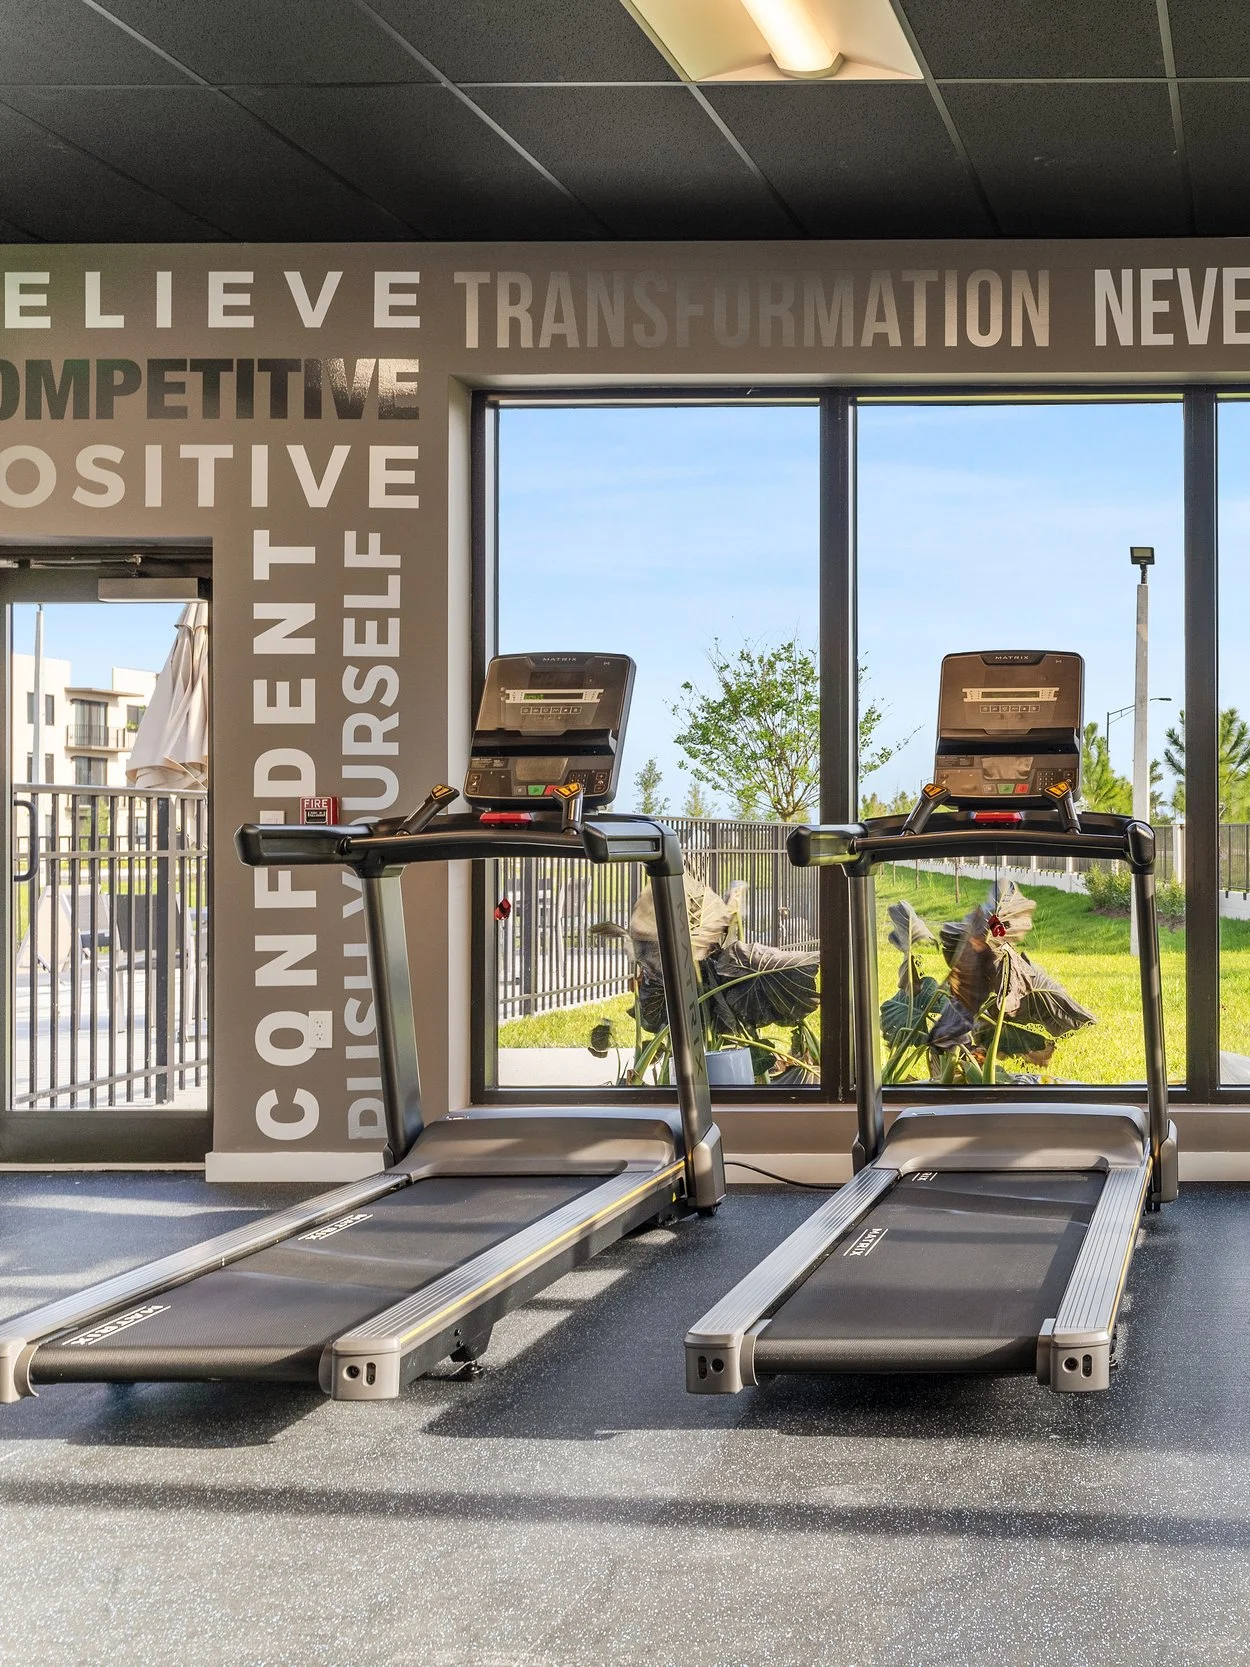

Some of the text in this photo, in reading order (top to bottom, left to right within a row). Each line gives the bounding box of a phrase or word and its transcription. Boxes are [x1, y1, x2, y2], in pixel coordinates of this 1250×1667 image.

[454, 269, 1050, 349] TRANSFORMATION
[341, 530, 402, 919] URSELF
[304, 799, 329, 808] FIRE
[253, 529, 321, 1141] CONFDENT
[307, 1213, 369, 1241] MATRIX
[849, 1227, 883, 1257] MATRIX
[71, 1304, 165, 1346] MATRIX
